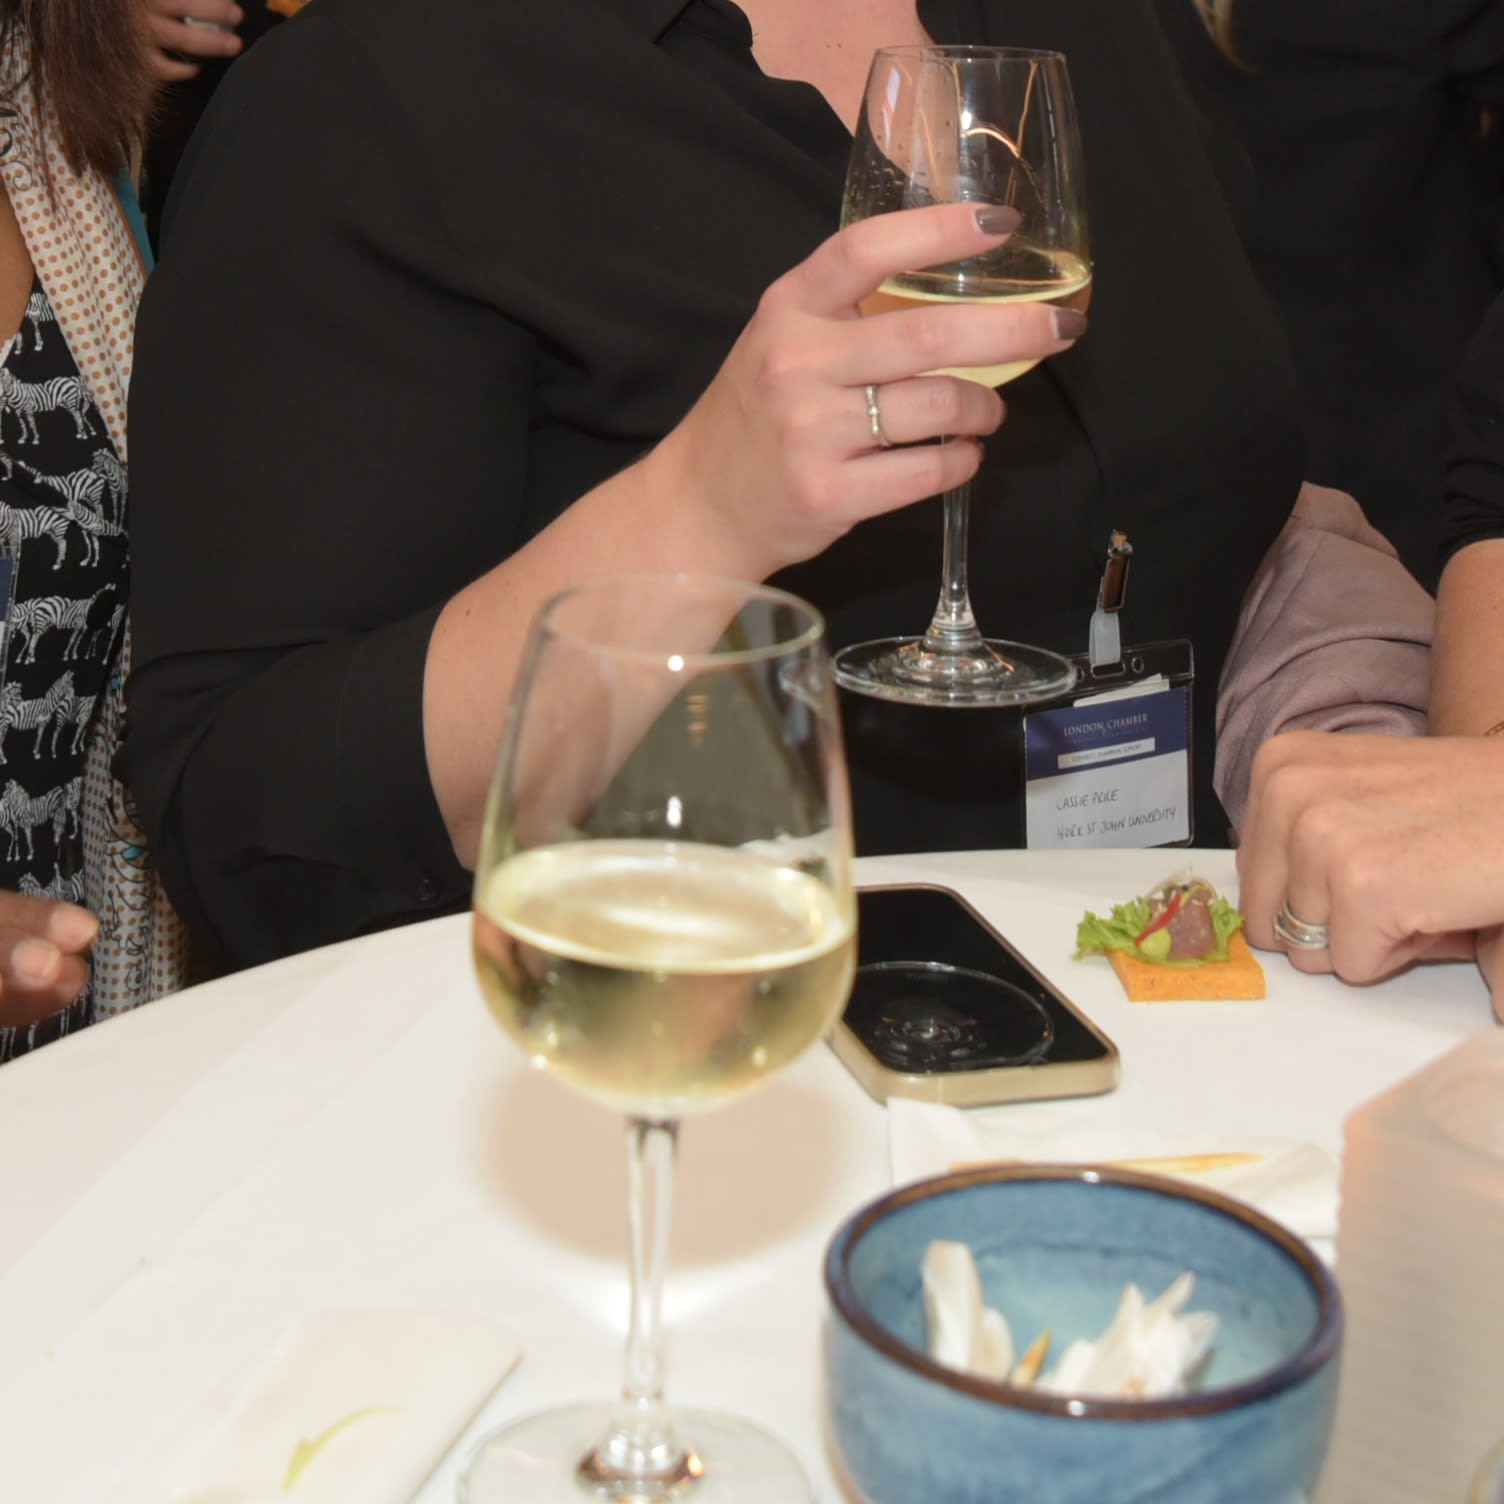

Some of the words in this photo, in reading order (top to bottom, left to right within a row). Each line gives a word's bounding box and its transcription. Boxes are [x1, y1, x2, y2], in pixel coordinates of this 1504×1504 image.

[1063, 721, 1104, 736] LONDON
[1106, 713, 1148, 729] CHAMBER
[1087, 822, 1097, 835] ST
[1101, 818, 1125, 834] JOHN
